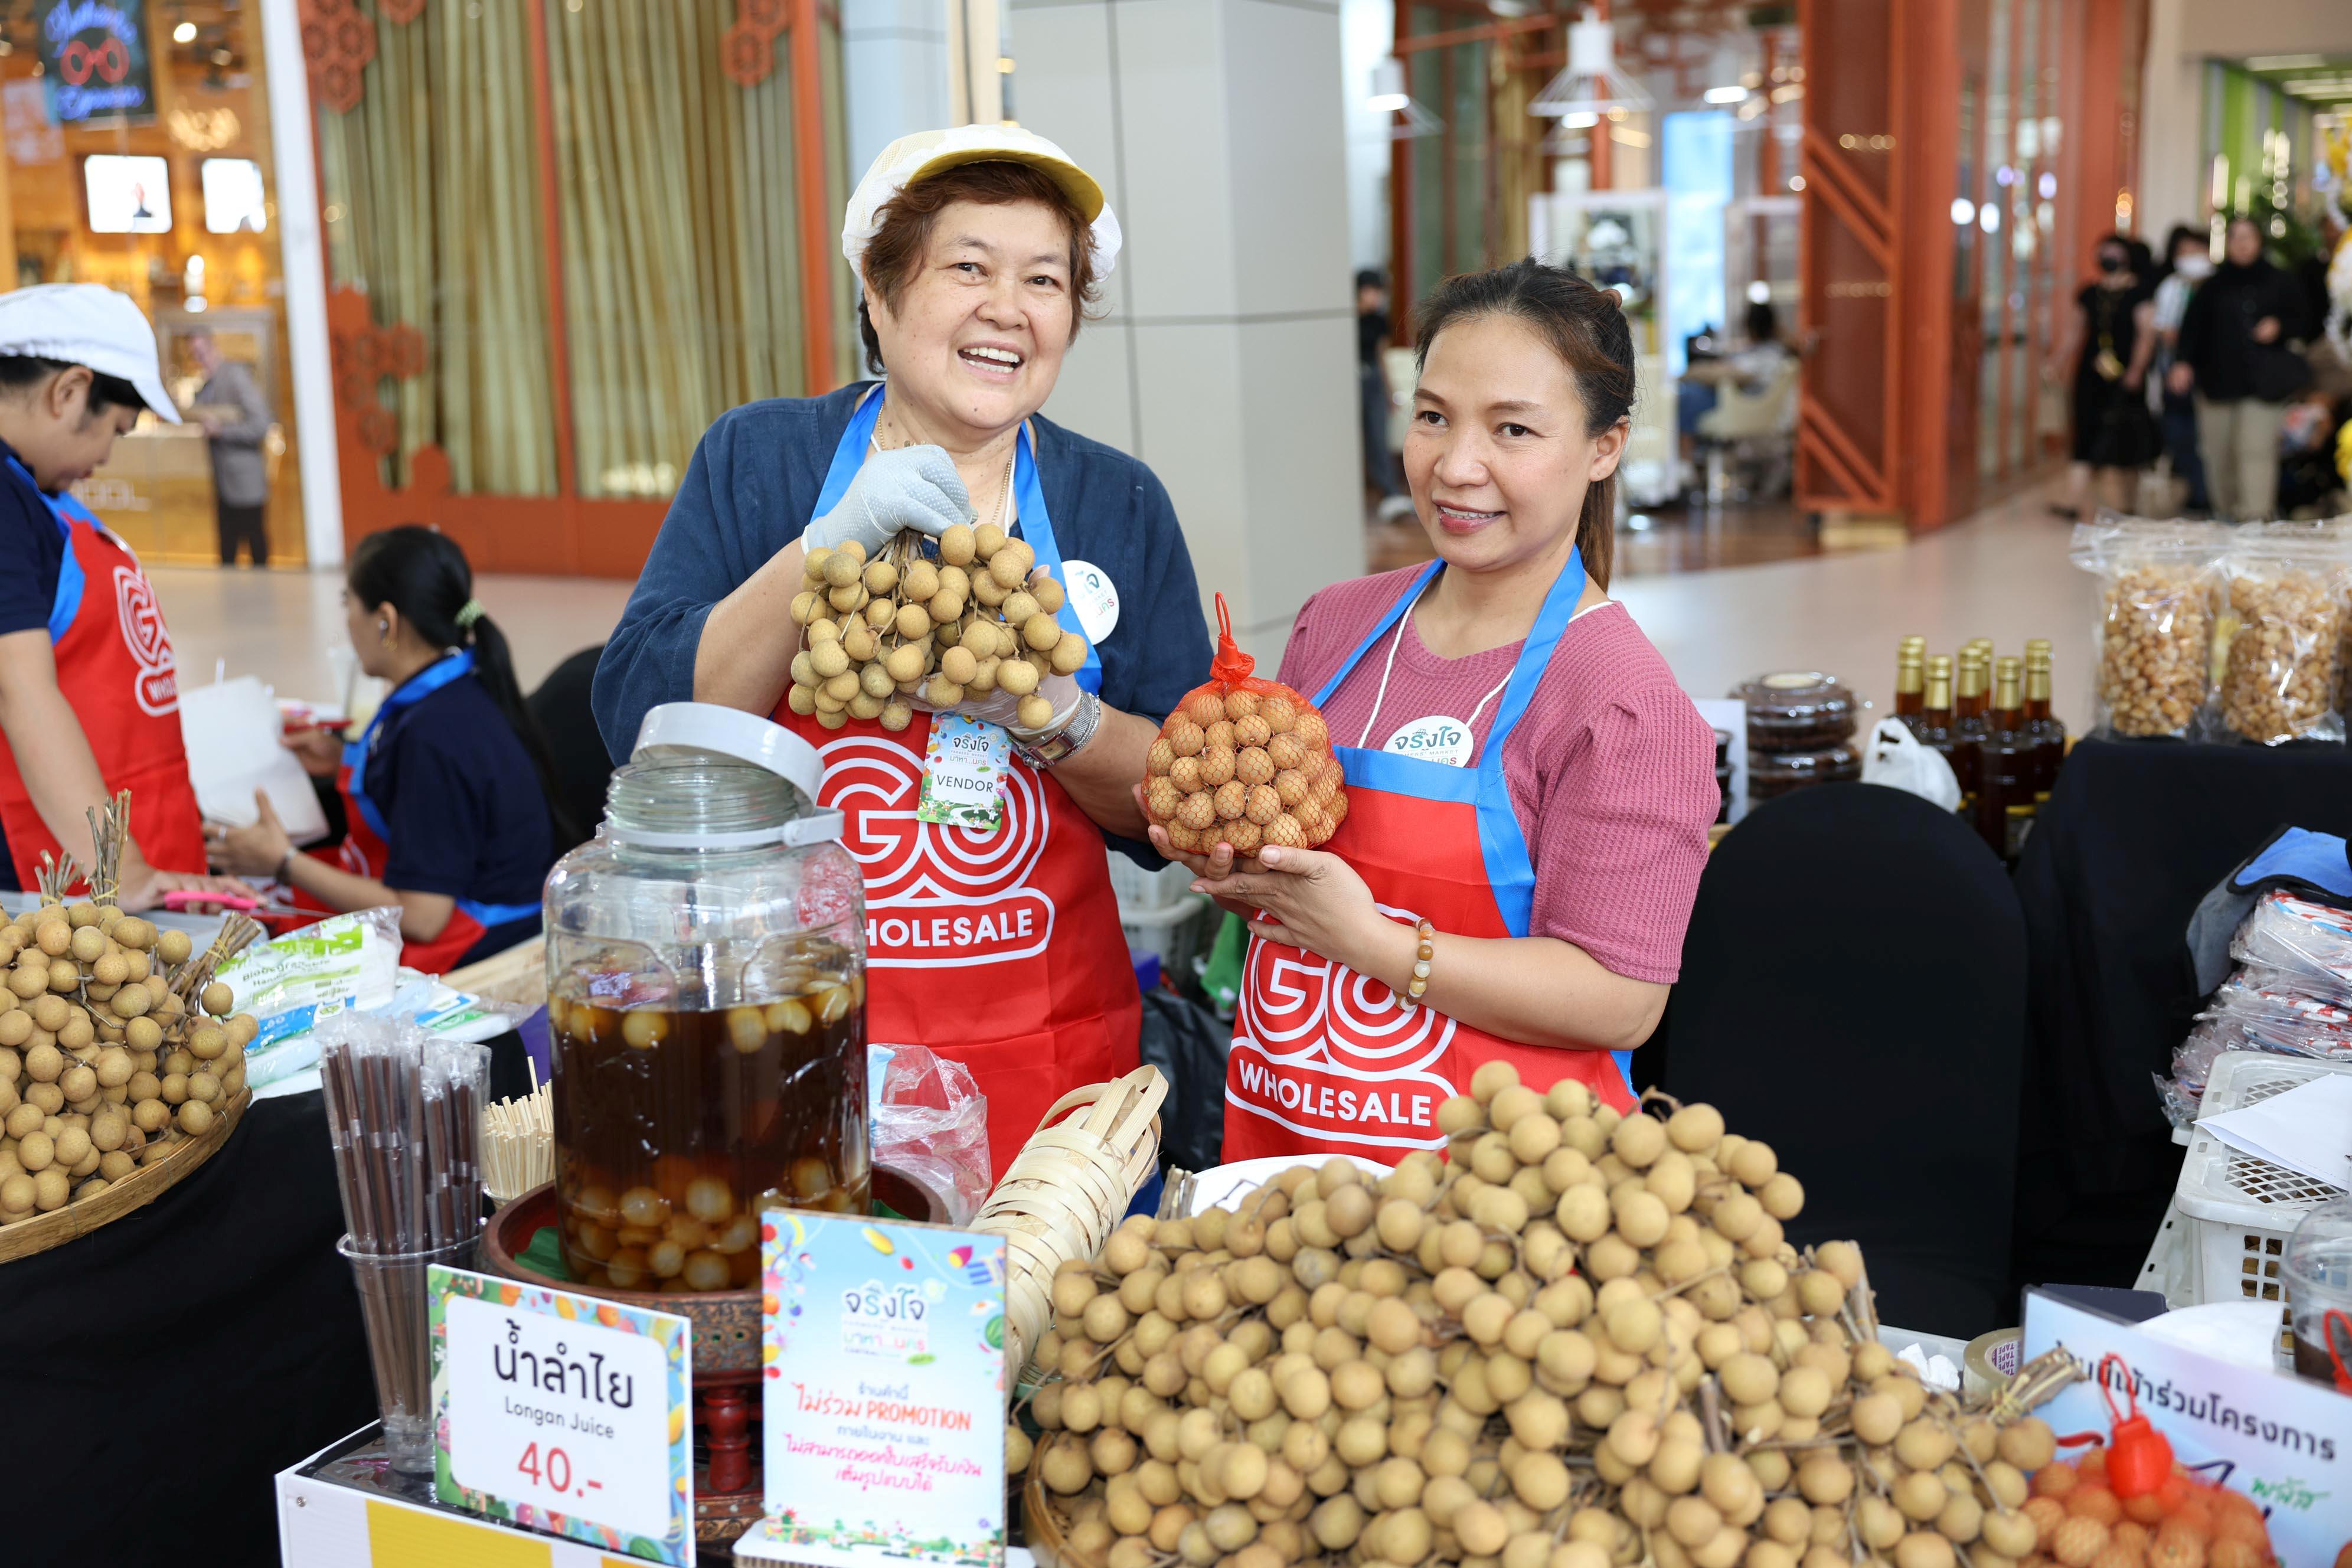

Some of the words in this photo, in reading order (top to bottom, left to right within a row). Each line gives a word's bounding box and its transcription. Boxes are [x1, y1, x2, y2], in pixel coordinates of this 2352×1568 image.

[953, 733, 989, 752] จริงใจ
[1394, 726, 1461, 750] จริงใจ
[937, 774, 993, 793] VENDOR
[866, 908, 1033, 947] HOLESALE
[1239, 1059, 1431, 1128] WHOLESALE
[845, 1285, 925, 1320] จริงใจ
[494, 1318, 633, 1409] น้ำลำไย
[1998, 1342, 2014, 1354] TAPE
[1998, 1351, 2014, 1363] TAPE
[1998, 1360, 2014, 1371] TAPE
[505, 1395, 565, 1427] Longan
[570, 1412, 614, 1439] Juice
[791, 1381, 862, 1417] ไม่ร่วม
[867, 1400, 972, 1431] PROMOTION
[517, 1441, 603, 1498] 40.-
